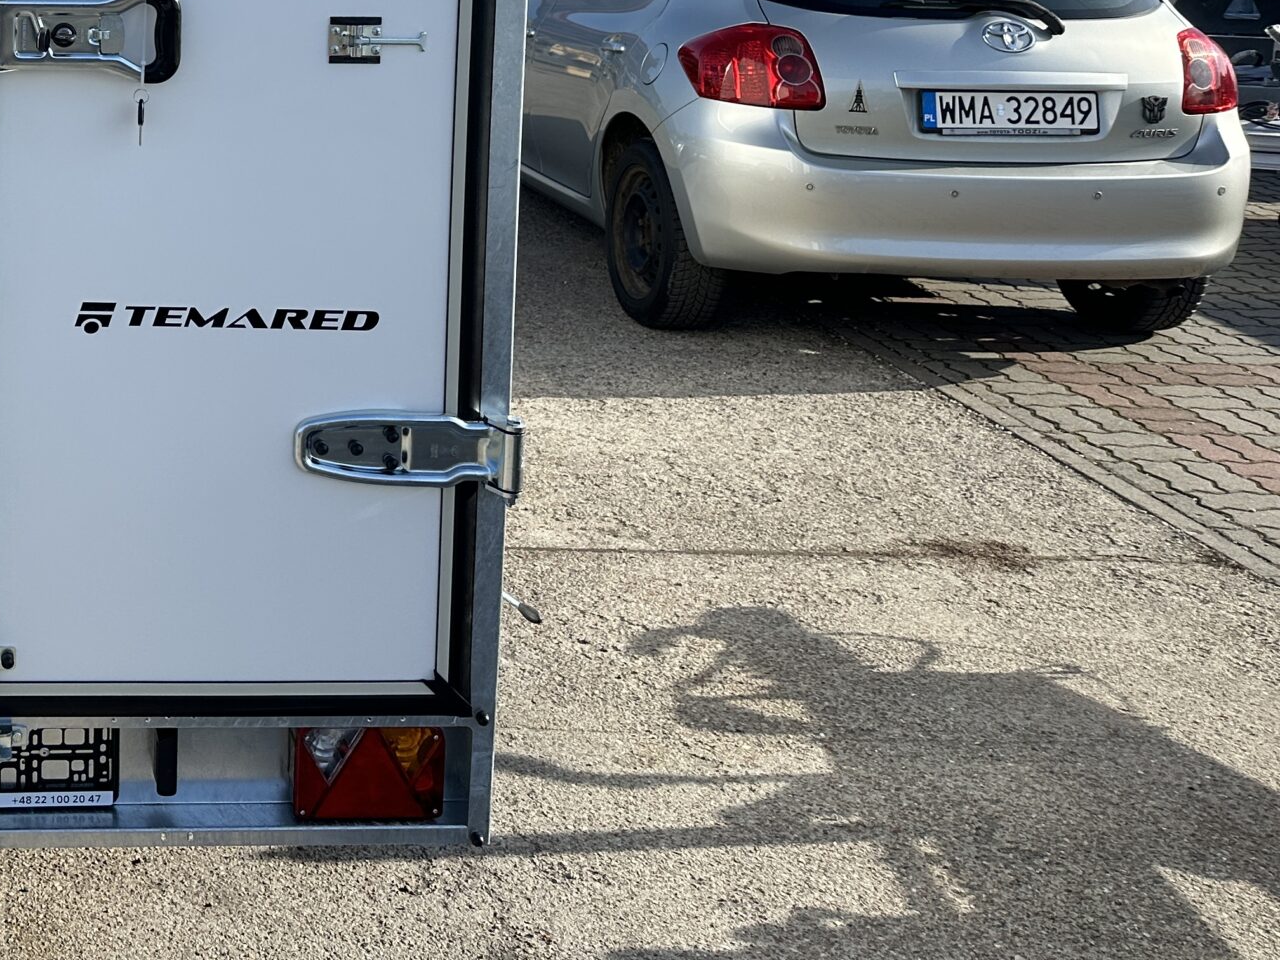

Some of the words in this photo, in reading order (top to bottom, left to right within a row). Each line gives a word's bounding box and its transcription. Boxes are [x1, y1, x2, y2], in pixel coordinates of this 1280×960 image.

[938, 95, 996, 125] WMA
[1005, 95, 1093, 126] 32849
[924, 114, 936, 123] PL
[1129, 127, 1180, 139] AURIS
[124, 305, 380, 332] TEMARED
[11, 796, 32, 805] +48
[35, 796, 47, 804] 22
[50, 795, 70, 804] 100
[72, 795, 86, 804] 20
[88, 794, 102, 803] 47
